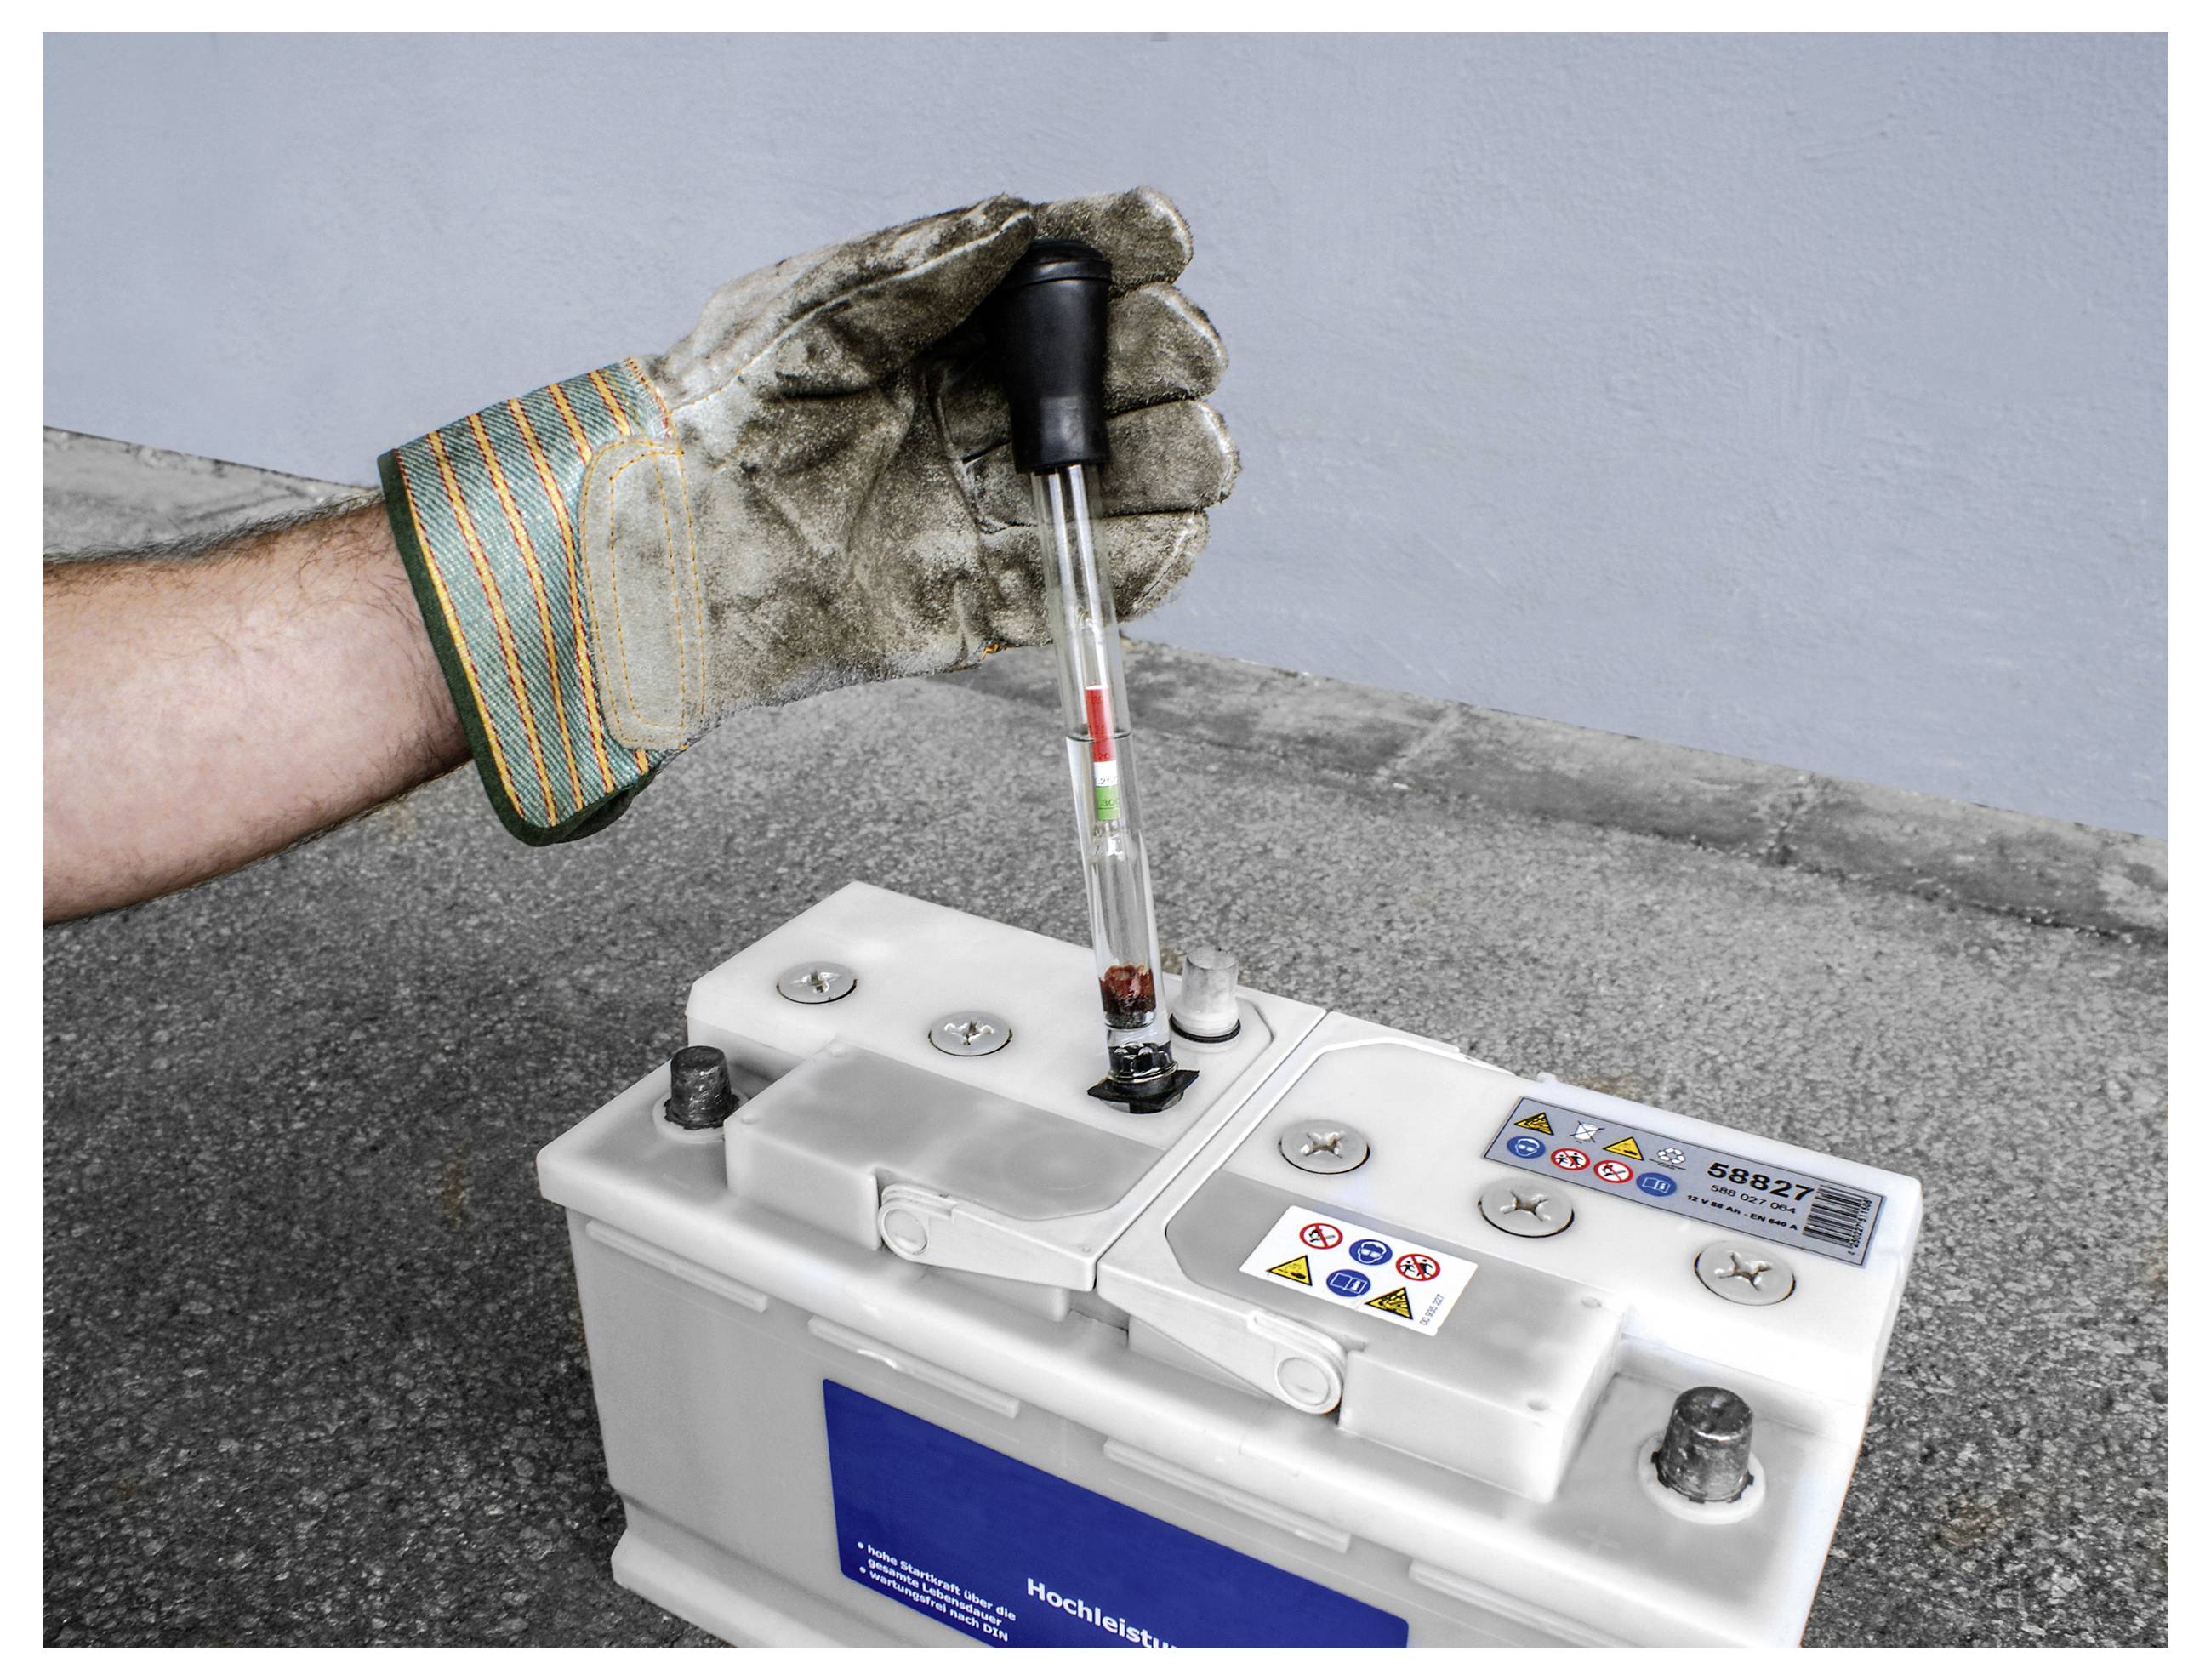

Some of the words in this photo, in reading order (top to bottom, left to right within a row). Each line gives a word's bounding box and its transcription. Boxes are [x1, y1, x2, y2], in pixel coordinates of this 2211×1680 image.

[1687, 1194, 1699, 1203] 12
[1726, 1205, 1741, 1215] Ah
[1750, 1213, 1766, 1222] EN
[1769, 1218, 1786, 1227] 640
[1707, 1162, 1815, 1201] 58827
[1711, 1184, 1736, 1197] 588
[1740, 1193, 1767, 1205] 027
[1770, 1202, 1796, 1215] 064
[867, 1544, 898, 1566] hohe
[899, 1560, 961, 1596] Startkraft
[964, 1589, 994, 1610] über
[995, 1605, 1017, 1622] die
[868, 1558, 920, 1588] gesamte
[922, 1582, 1003, 1626] Lebensdauer
[869, 1570, 947, 1614] wartungsfrei
[949, 1609, 980, 1628] nach
[983, 1623, 1009, 1642] DIN
[1027, 1577, 1177, 1648] Hochleistu
